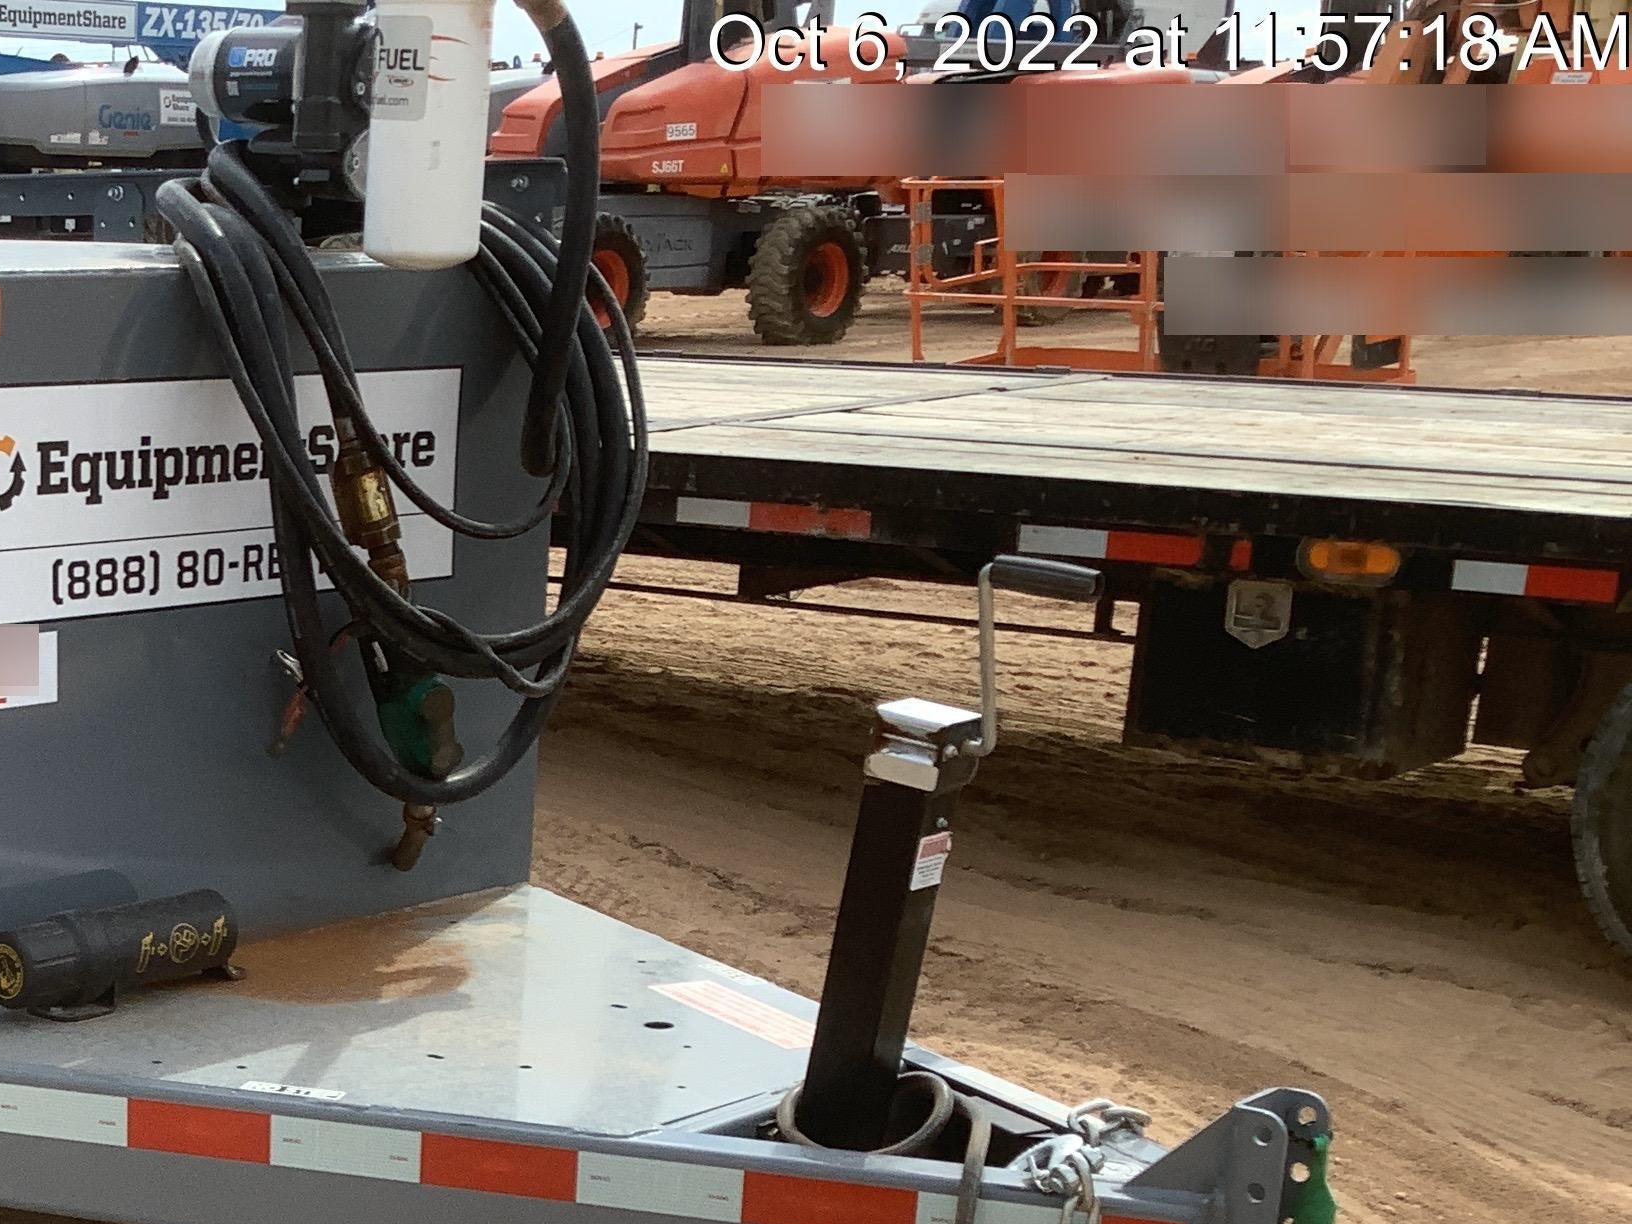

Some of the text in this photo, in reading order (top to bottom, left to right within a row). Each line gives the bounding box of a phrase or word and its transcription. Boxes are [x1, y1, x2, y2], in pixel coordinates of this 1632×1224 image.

[377, 48, 425, 71] FUEL
[98, 103, 156, 130] Genie
[667, 124, 696, 138] 9565
[37, 424, 436, 505] EquipmeSre
[52, 550, 160, 605] (888)
